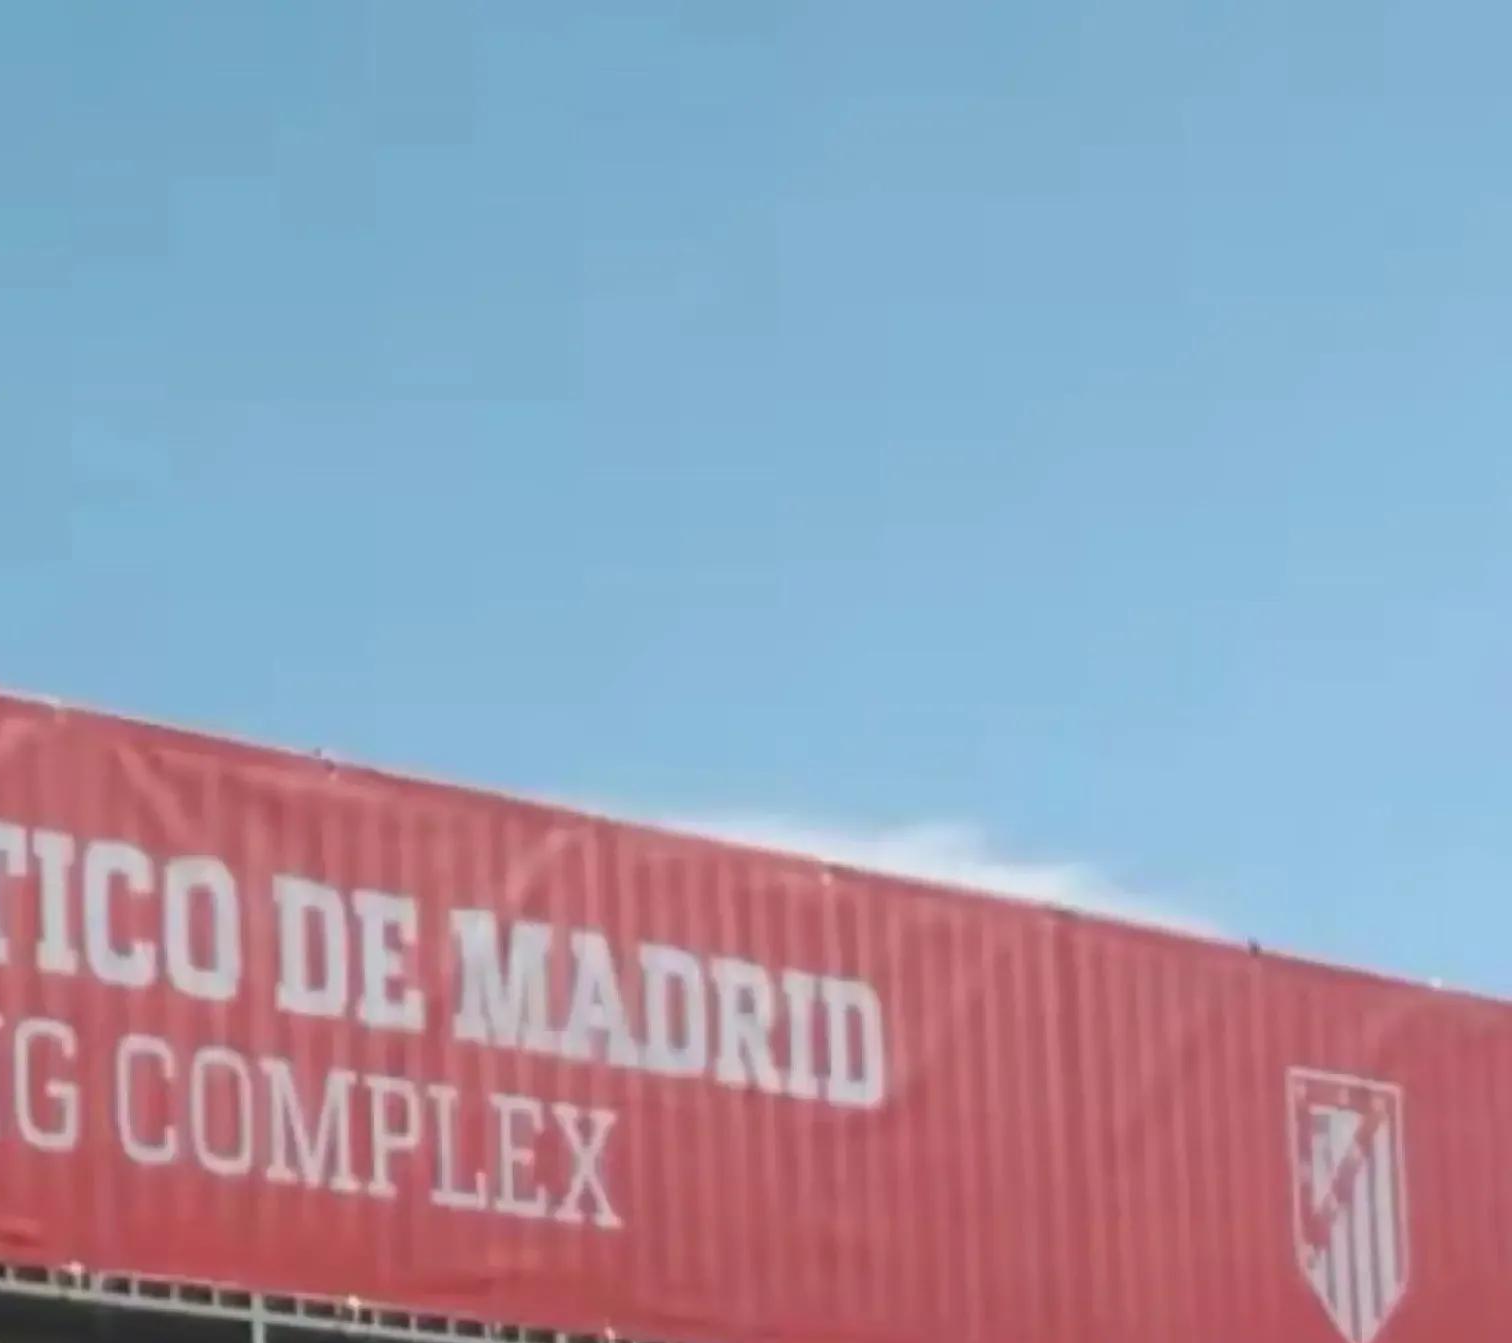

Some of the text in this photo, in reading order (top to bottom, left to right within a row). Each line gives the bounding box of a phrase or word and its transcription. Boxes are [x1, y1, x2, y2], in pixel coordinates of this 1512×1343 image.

[272, 872, 427, 1034] DE
[450, 908, 886, 1109] MADRID
[115, 1033, 623, 1228] COMPLEX
